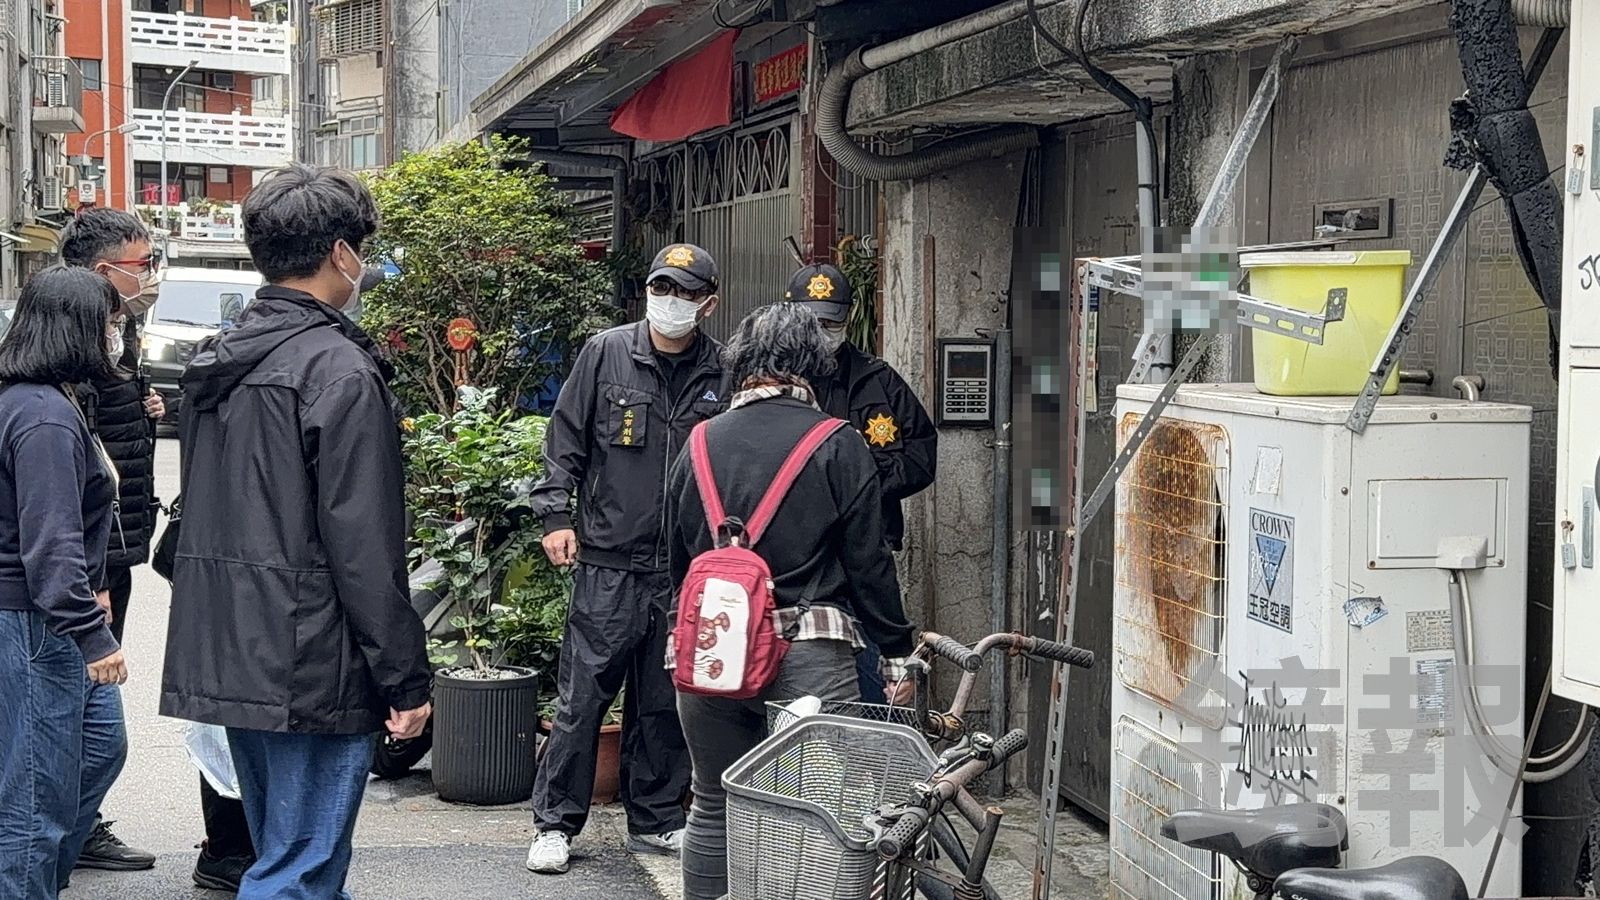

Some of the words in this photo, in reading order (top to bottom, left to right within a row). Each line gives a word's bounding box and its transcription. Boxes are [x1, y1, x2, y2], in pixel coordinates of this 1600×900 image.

[622, 409, 634, 446] 北市刑警
[1251, 512, 1291, 540] CROWN
[1249, 593, 1291, 630] 王冠空調
